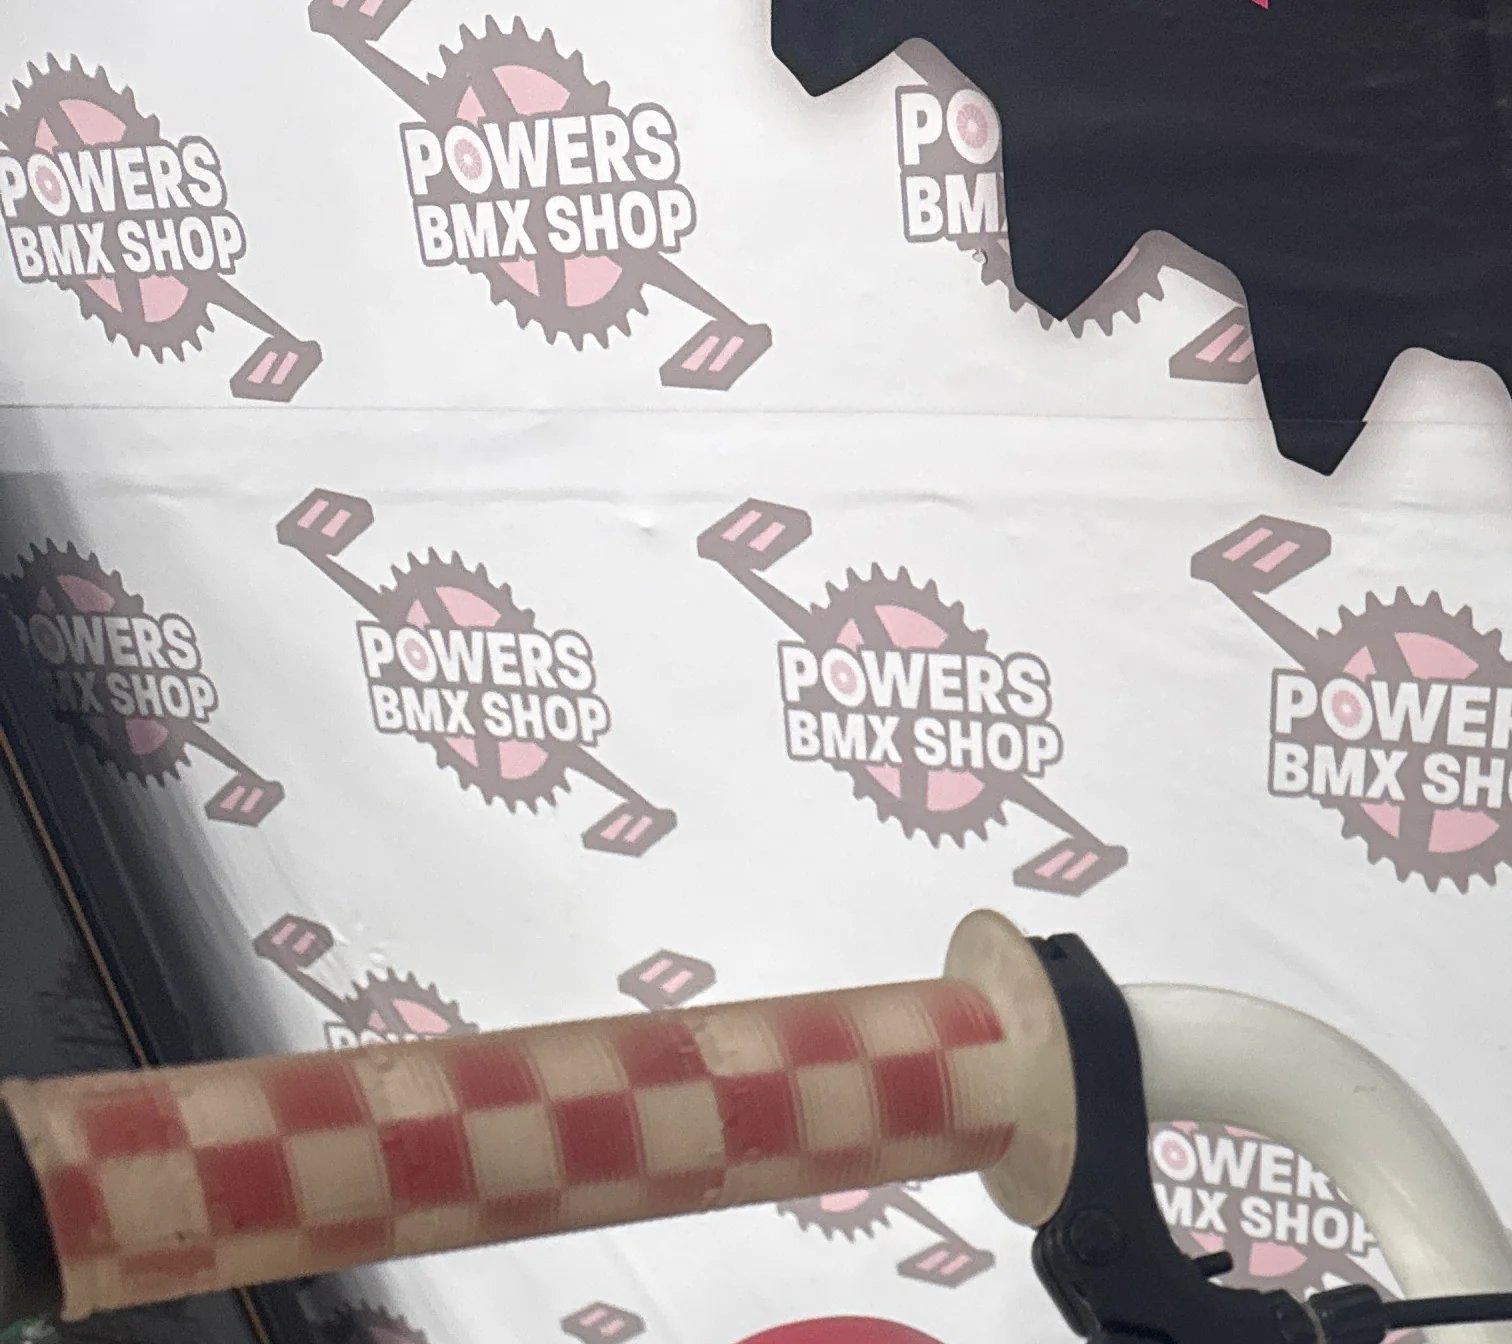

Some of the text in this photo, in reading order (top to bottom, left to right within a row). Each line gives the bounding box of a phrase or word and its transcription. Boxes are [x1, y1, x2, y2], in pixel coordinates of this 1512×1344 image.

[0, 142, 224, 218] POWERS
[408, 107, 677, 197] POWERS
[418, 192, 694, 261] BMX SHOP
[903, 176, 1004, 236] BM
[10, 215, 243, 278] BMX SHOP
[359, 625, 594, 691] POWERS
[781, 646, 1051, 719] POWERS
[106, 672, 215, 721] SHOP
[371, 684, 609, 743] BMX SHOP
[789, 710, 1061, 774] BMX SHOP
[1275, 744, 1405, 801] BMX
[1154, 1183, 1229, 1234] MX
